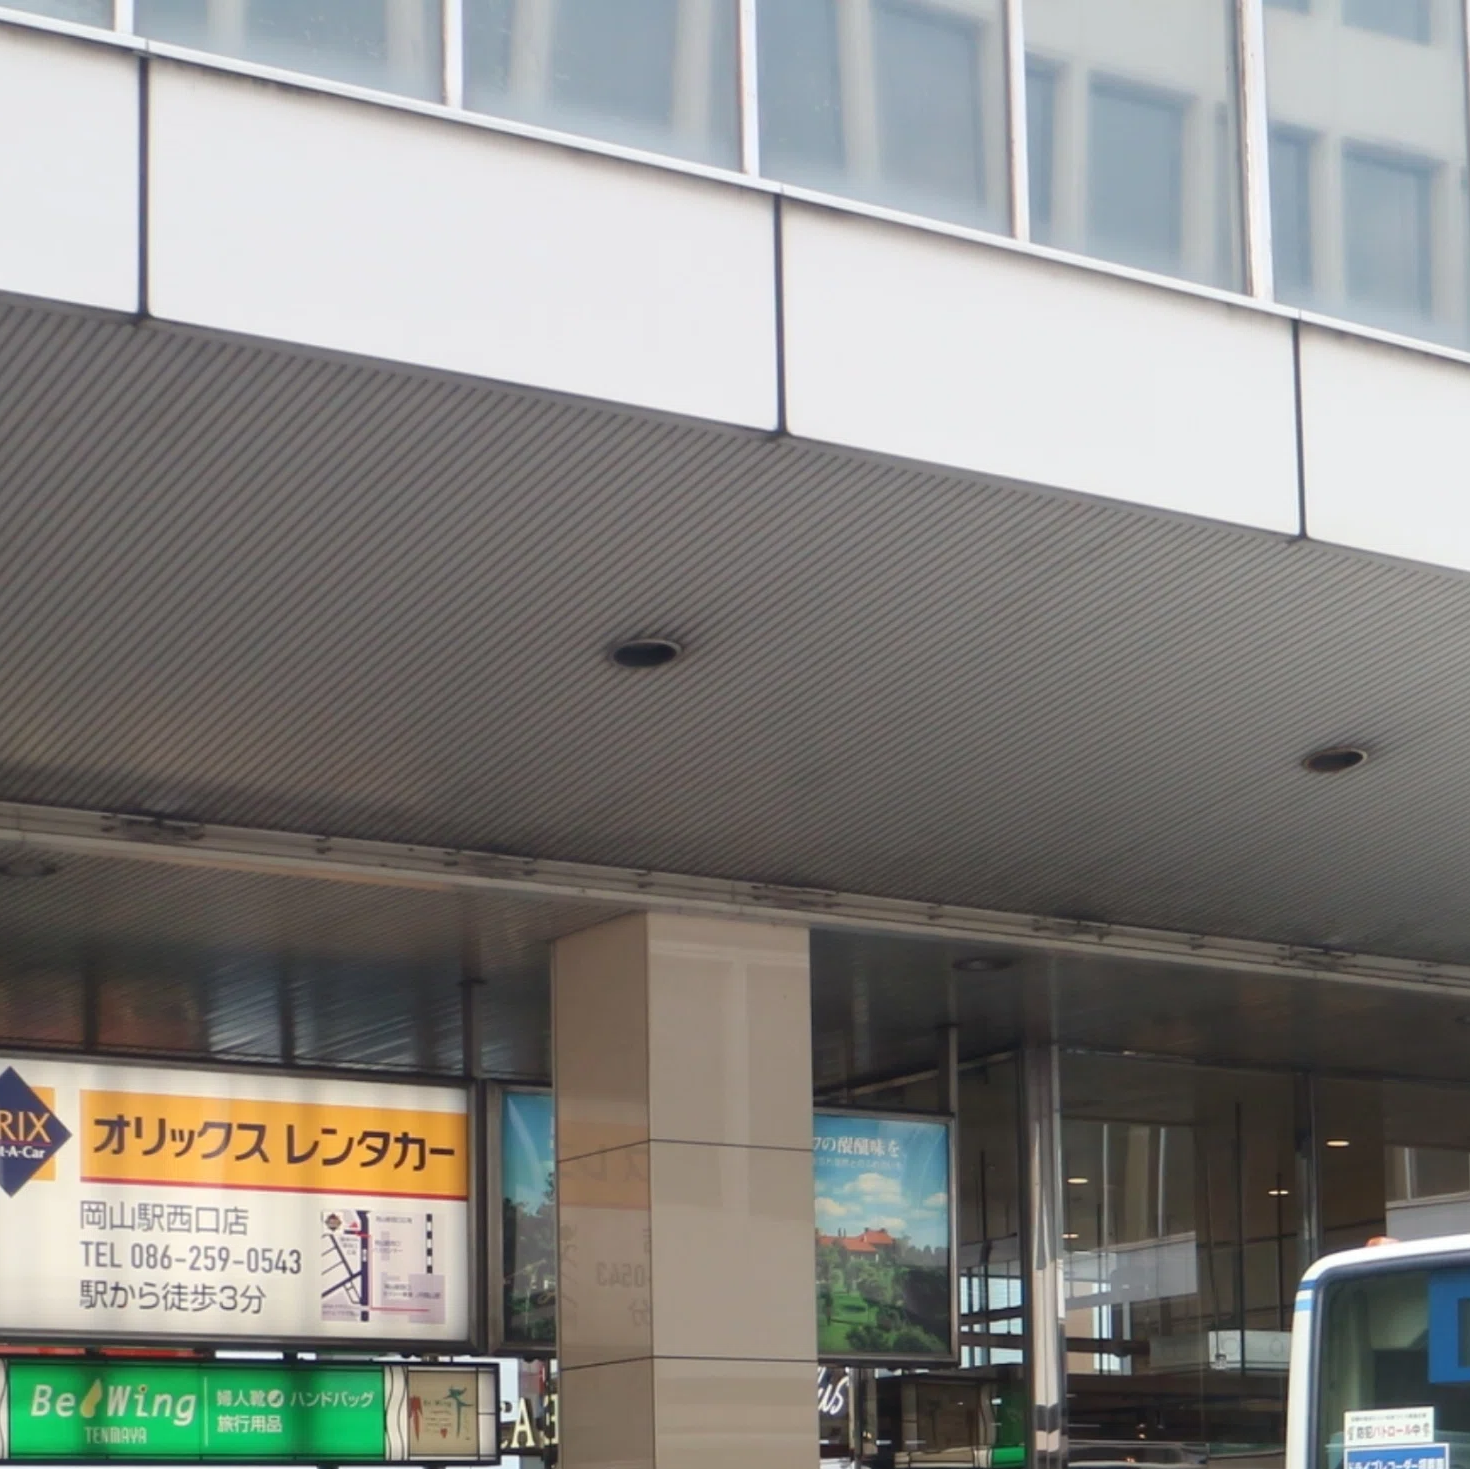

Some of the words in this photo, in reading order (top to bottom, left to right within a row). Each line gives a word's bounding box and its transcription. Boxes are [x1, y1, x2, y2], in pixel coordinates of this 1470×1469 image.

[93, 1113, 269, 1163] オリックス
[287, 1127, 455, 1173] レンタカー
[79, 1200, 249, 1236] 岡山駅西口店
[81, 1241, 122, 1269] TEL
[130, 1242, 303, 1276] 086-259-0543
[79, 1280, 267, 1315] 駅から徒歩3分
[31, 1384, 75, 1418] Be
[107, 1384, 196, 1426] Wing
[85, 1426, 148, 1444] TENMAYA
[216, 1415, 282, 1433] 旅行用品
